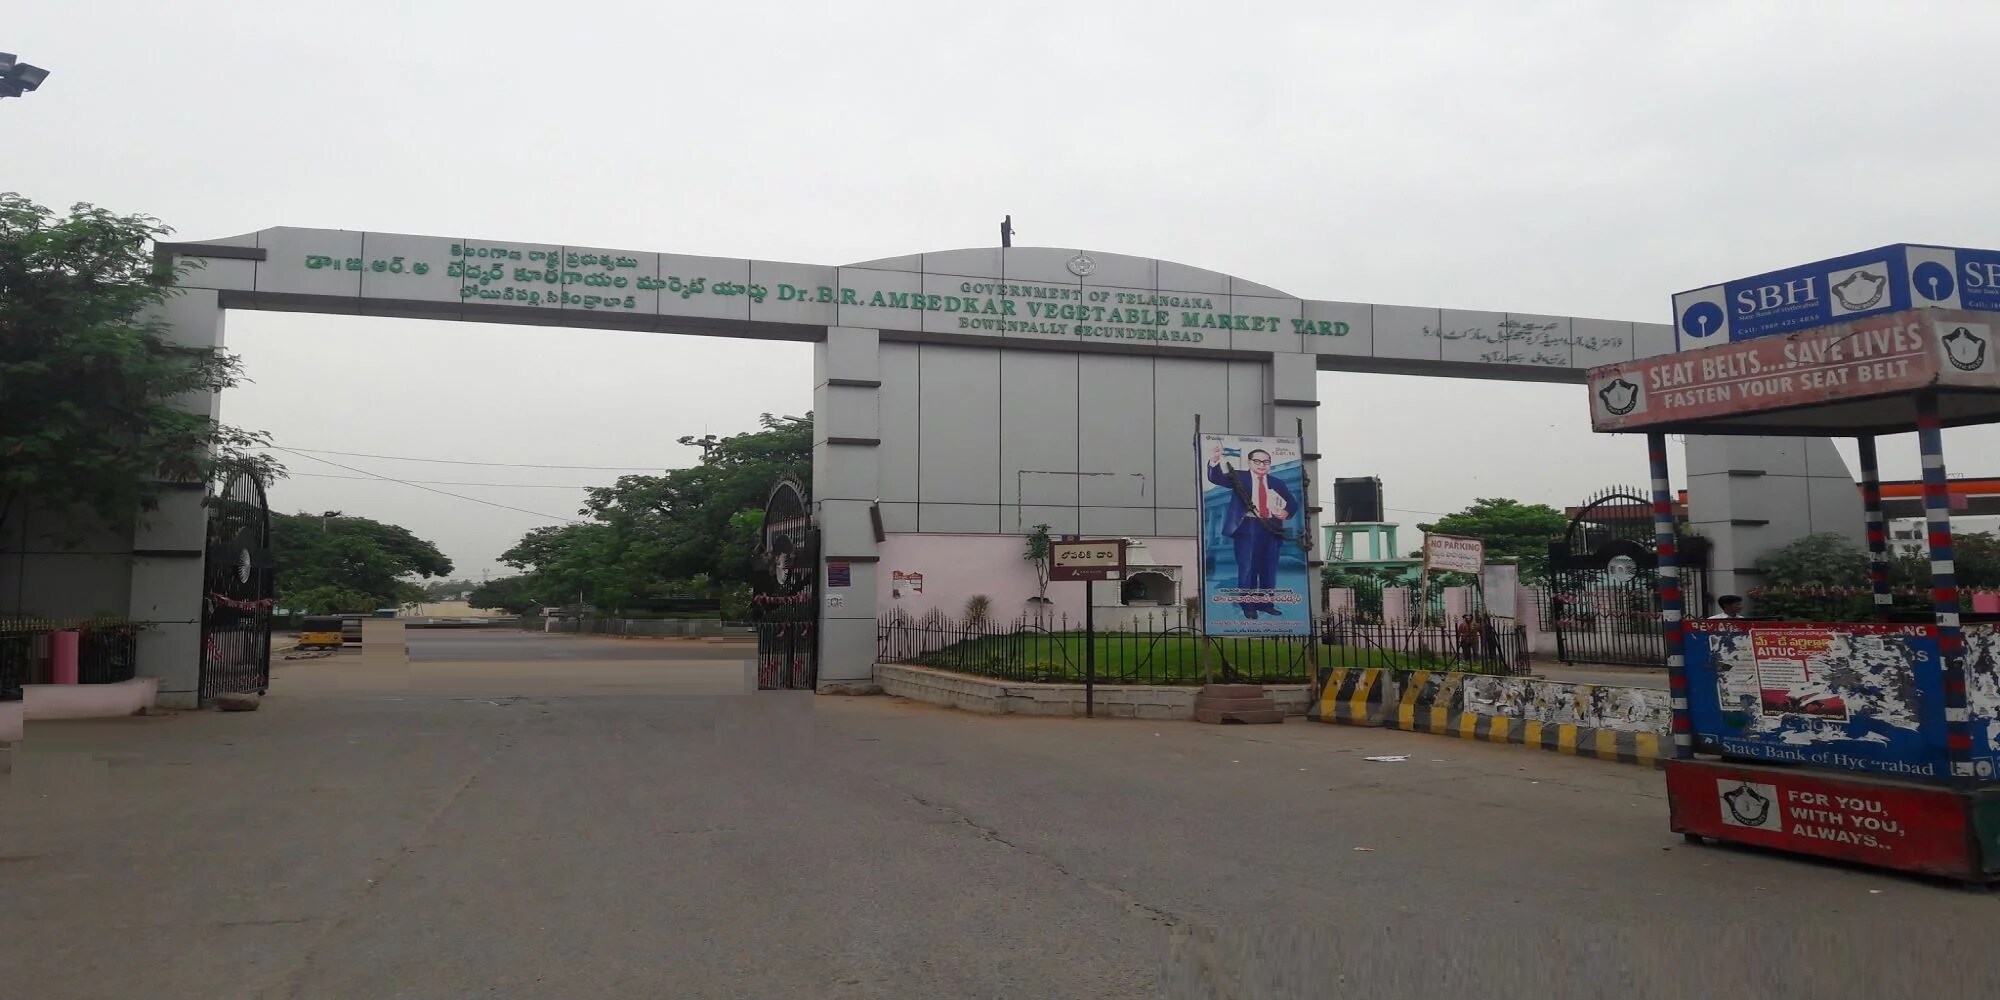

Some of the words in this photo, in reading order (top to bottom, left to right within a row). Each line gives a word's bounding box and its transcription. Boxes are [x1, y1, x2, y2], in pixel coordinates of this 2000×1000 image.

[960, 282, 1082, 301] GOVERNMENT
[1088, 290, 1111, 303] OF
[1117, 292, 1213, 310] TELANGANA
[1737, 276, 1816, 316] SBH
[958, 316, 1069, 335] BOWENPALLY
[1073, 325, 1204, 343] SECUNDERABAD
[1026, 300, 1170, 326] VEGETABLE
[1182, 312, 1281, 332] MARKET
[1290, 318, 1350, 336] YARD
[1650, 360, 1694, 390] SEAT
[1852, 322, 1923, 358] LIVES
[1664, 386, 1732, 408] FASTEN
[1737, 376, 1794, 398] YOUR
[1800, 368, 1849, 390] SEAT
[1858, 360, 1910, 382] BELT
[1430, 540, 1442, 548] NO
[1444, 540, 1480, 552] PARKING
[1757, 646, 1796, 656] AITUC
[1722, 741, 1760, 756] State
[1765, 746, 1806, 761] Bank
[1812, 752, 1830, 764] of
[1788, 790, 1829, 806] FOR
[1835, 796, 1889, 817] YOU,
[1790, 807, 1844, 825] WITH
[1850, 815, 1905, 837] YOU,
